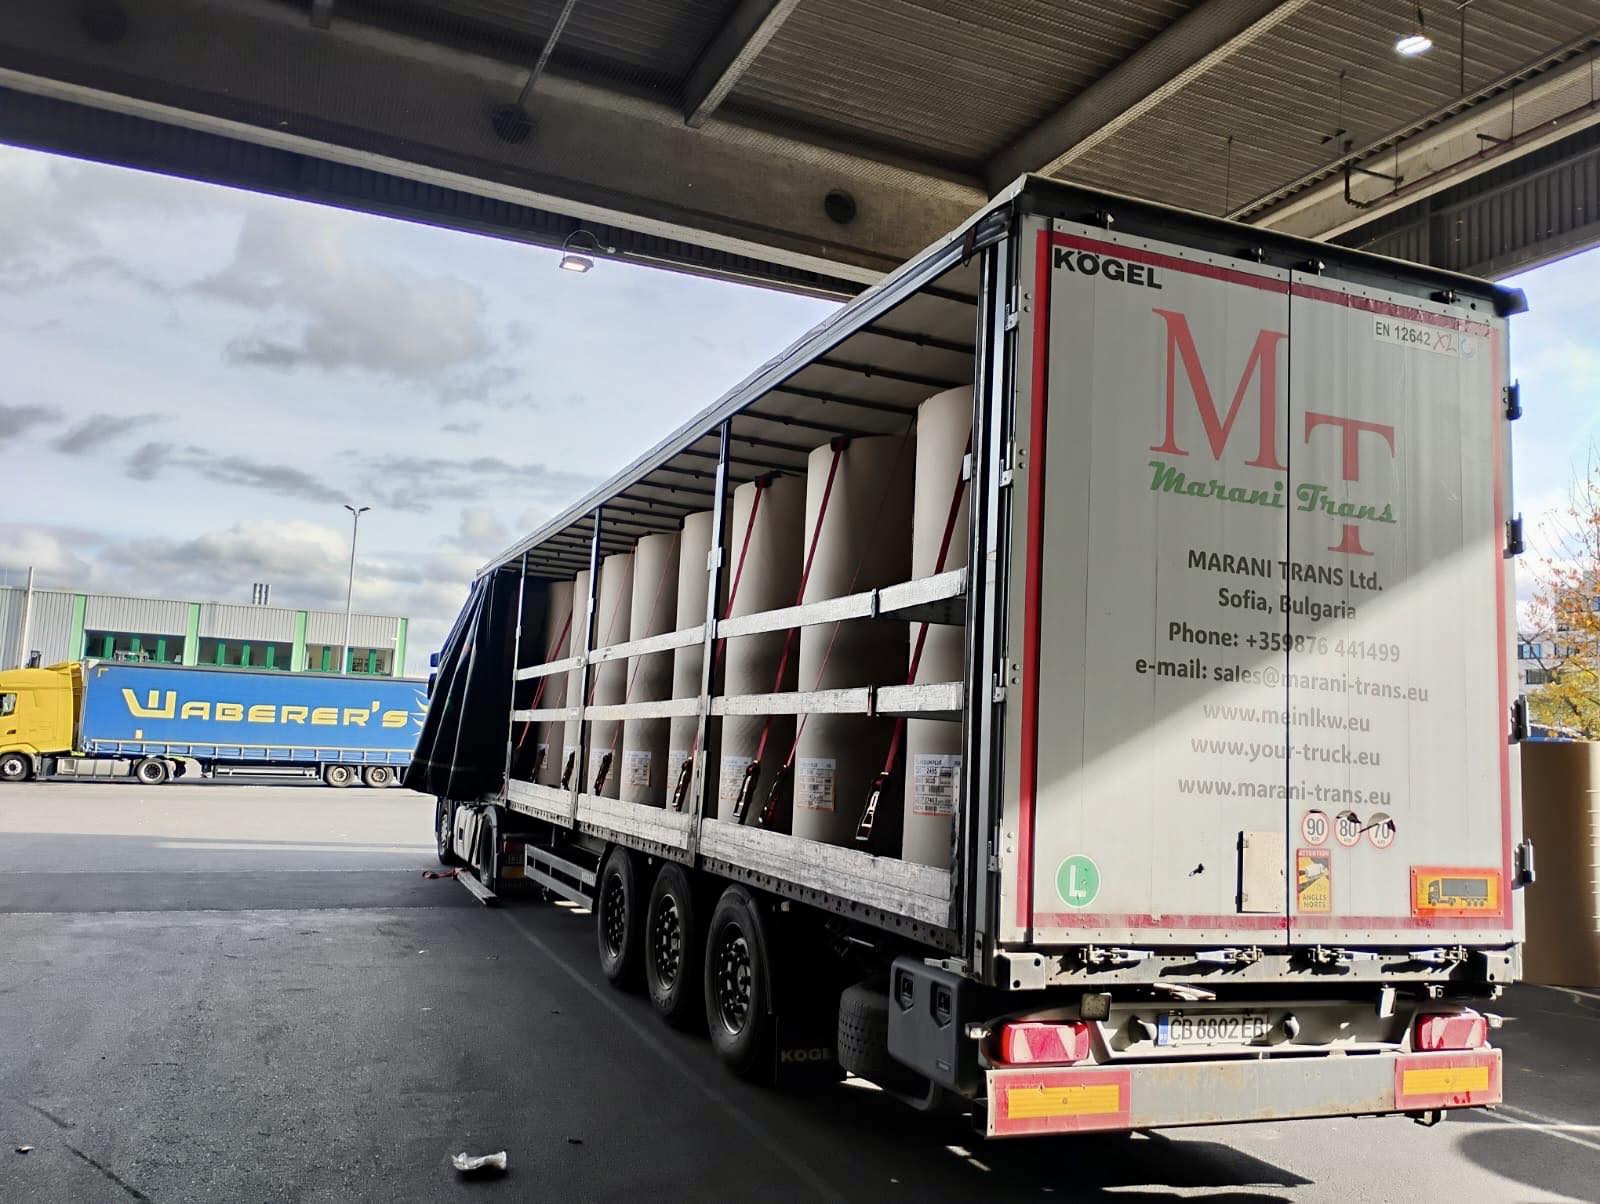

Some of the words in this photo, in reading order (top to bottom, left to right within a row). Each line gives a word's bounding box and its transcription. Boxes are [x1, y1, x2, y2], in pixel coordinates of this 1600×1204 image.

[1054, 247, 1162, 290] KÖGEL
[1375, 321, 1390, 337] EN
[1395, 325, 1431, 346] 12642
[1149, 461, 1286, 508] Marani
[1296, 483, 1397, 525] Trans
[1188, 549, 1272, 578] MARANI
[1278, 561, 1344, 587] TRANS
[1350, 570, 1383, 591] Ltd.
[1218, 587, 1273, 615] Sofia,
[1280, 594, 1356, 622] Bulgaria
[1168, 621, 1239, 648] Phone:
[1246, 631, 1328, 656] +359876
[1334, 639, 1401, 663] 441499
[1135, 658, 1208, 680] e-mail:
[1213, 664, 1429, 702] sales@marani-trans.eu
[122, 688, 409, 728] WABERER'S
[1203, 703, 1370, 733] www.meinlkw.eu
[1191, 737, 1381, 766] www.your-truck.eu
[1178, 777, 1391, 806] www.marani-trans.eu
[1307, 818, 1325, 836] 90
[1340, 819, 1357, 838] 80
[1375, 822, 1390, 840] 70
[1069, 864, 1087, 898] L
